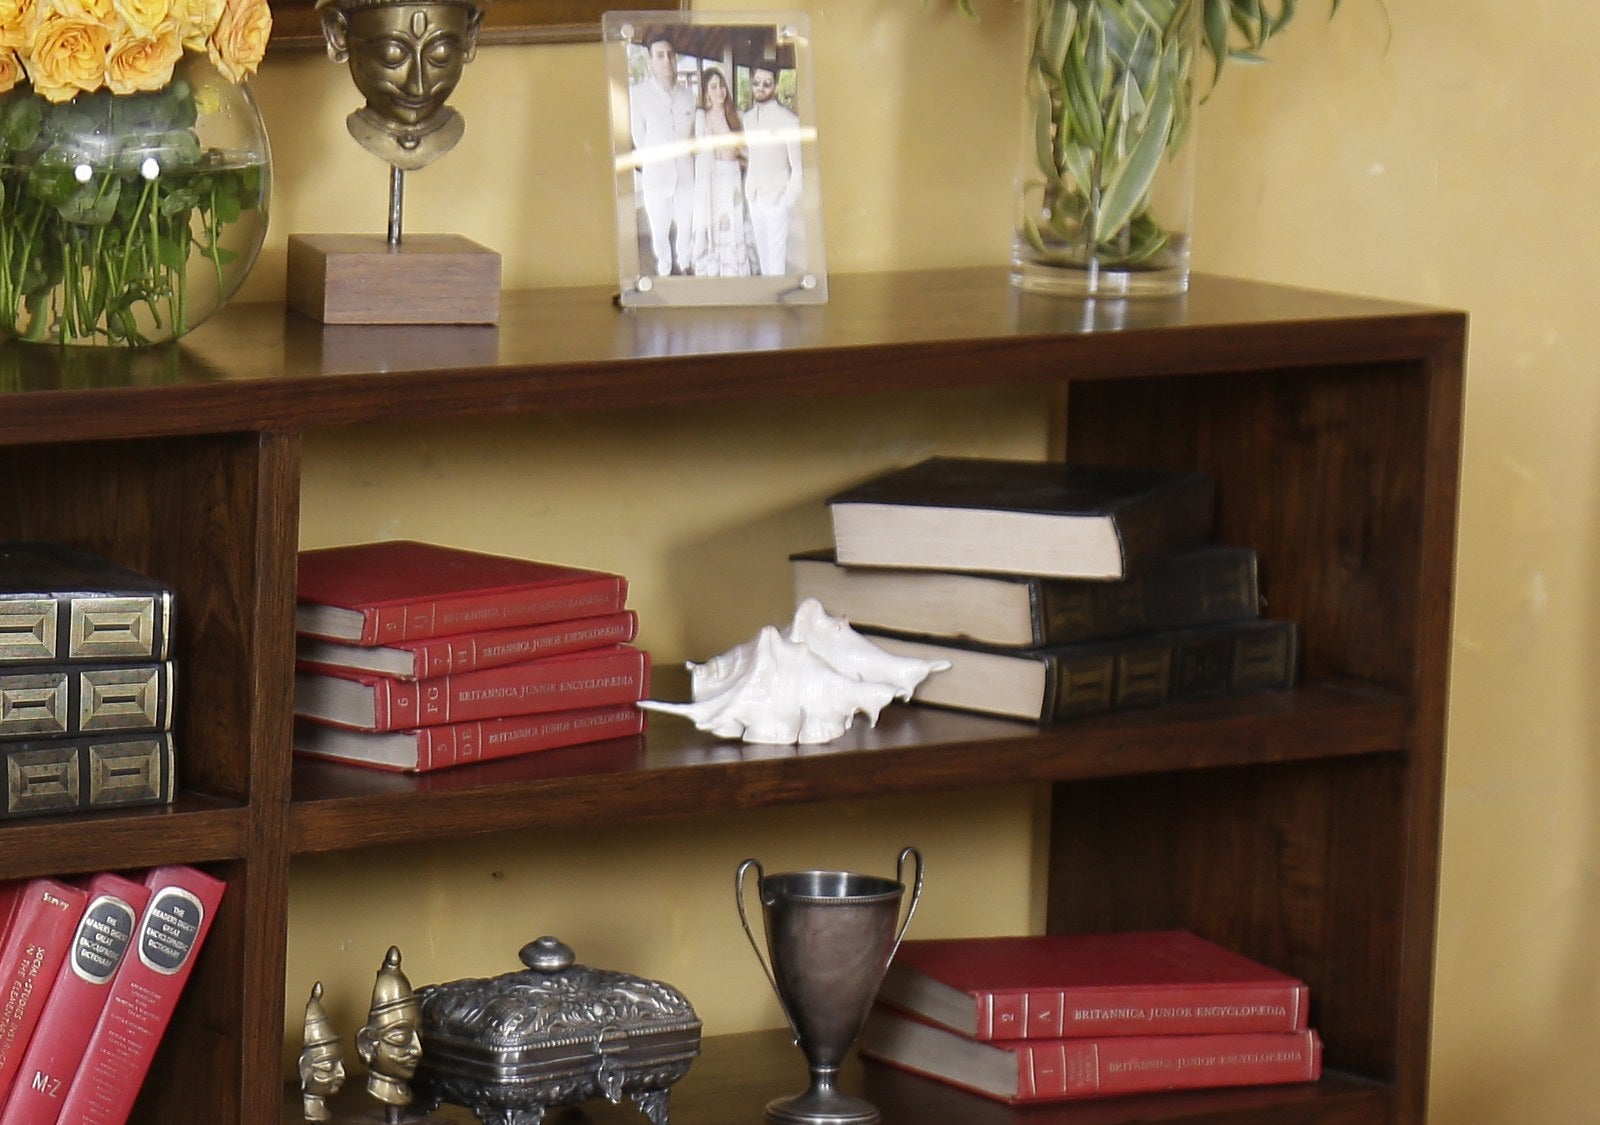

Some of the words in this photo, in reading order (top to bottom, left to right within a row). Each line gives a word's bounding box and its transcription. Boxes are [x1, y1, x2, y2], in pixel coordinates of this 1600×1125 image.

[483, 641, 531, 659] BRITANNICA
[459, 686, 518, 702] BRITANNICA
[519, 683, 557, 698] JUNIOR
[398, 697, 409, 707] 6
[489, 727, 539, 744] BRITANNICA
[17, 959, 31, 978] THE
[1001, 1013, 1014, 1022] 2
[1039, 1010, 1050, 1021] A
[1074, 1008, 1145, 1020] BRITANNICA
[1148, 1006, 1192, 1020] JUNIOR
[1177, 1055, 1216, 1070] JUNIOR
[31, 1070, 62, 1098] M-Z
